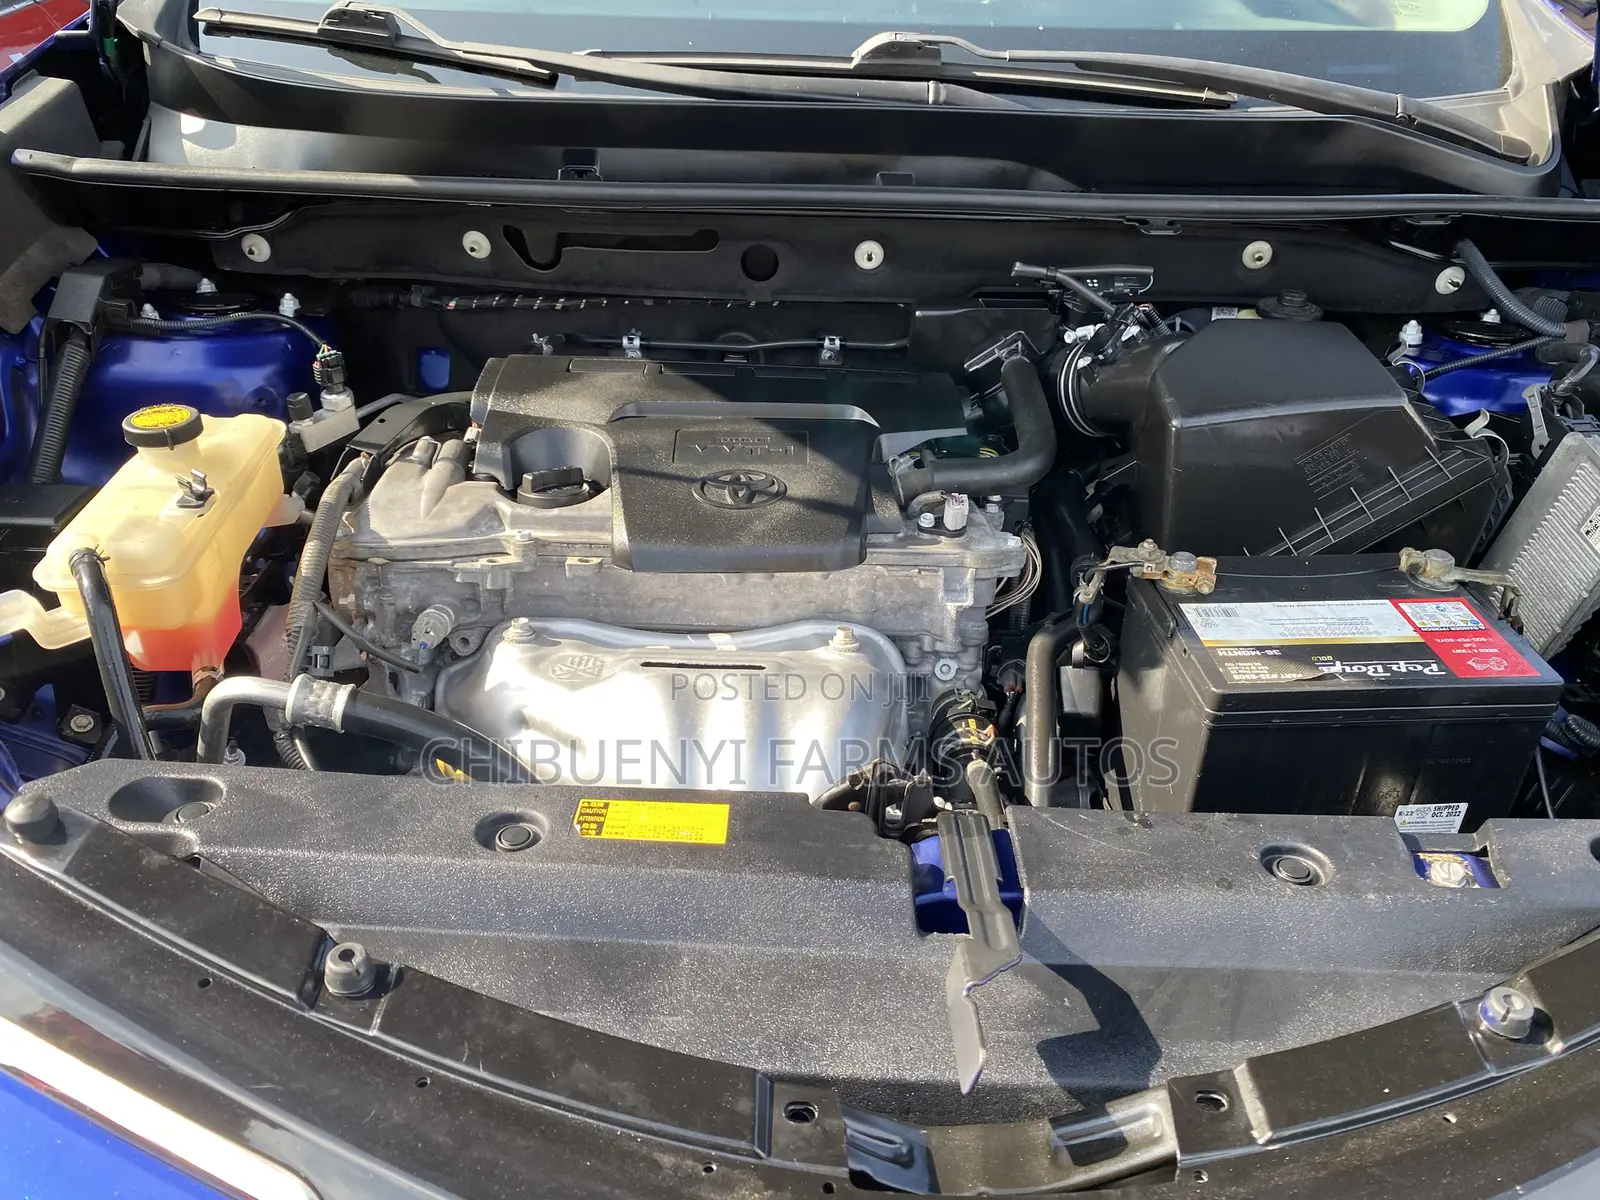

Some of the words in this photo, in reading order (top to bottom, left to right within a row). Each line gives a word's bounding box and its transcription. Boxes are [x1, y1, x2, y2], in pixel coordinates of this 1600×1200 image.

[1386, 660, 1446, 676] Pep
[581, 807, 608, 815] CAUTION
[1433, 804, 1460, 812] SHIPPED
